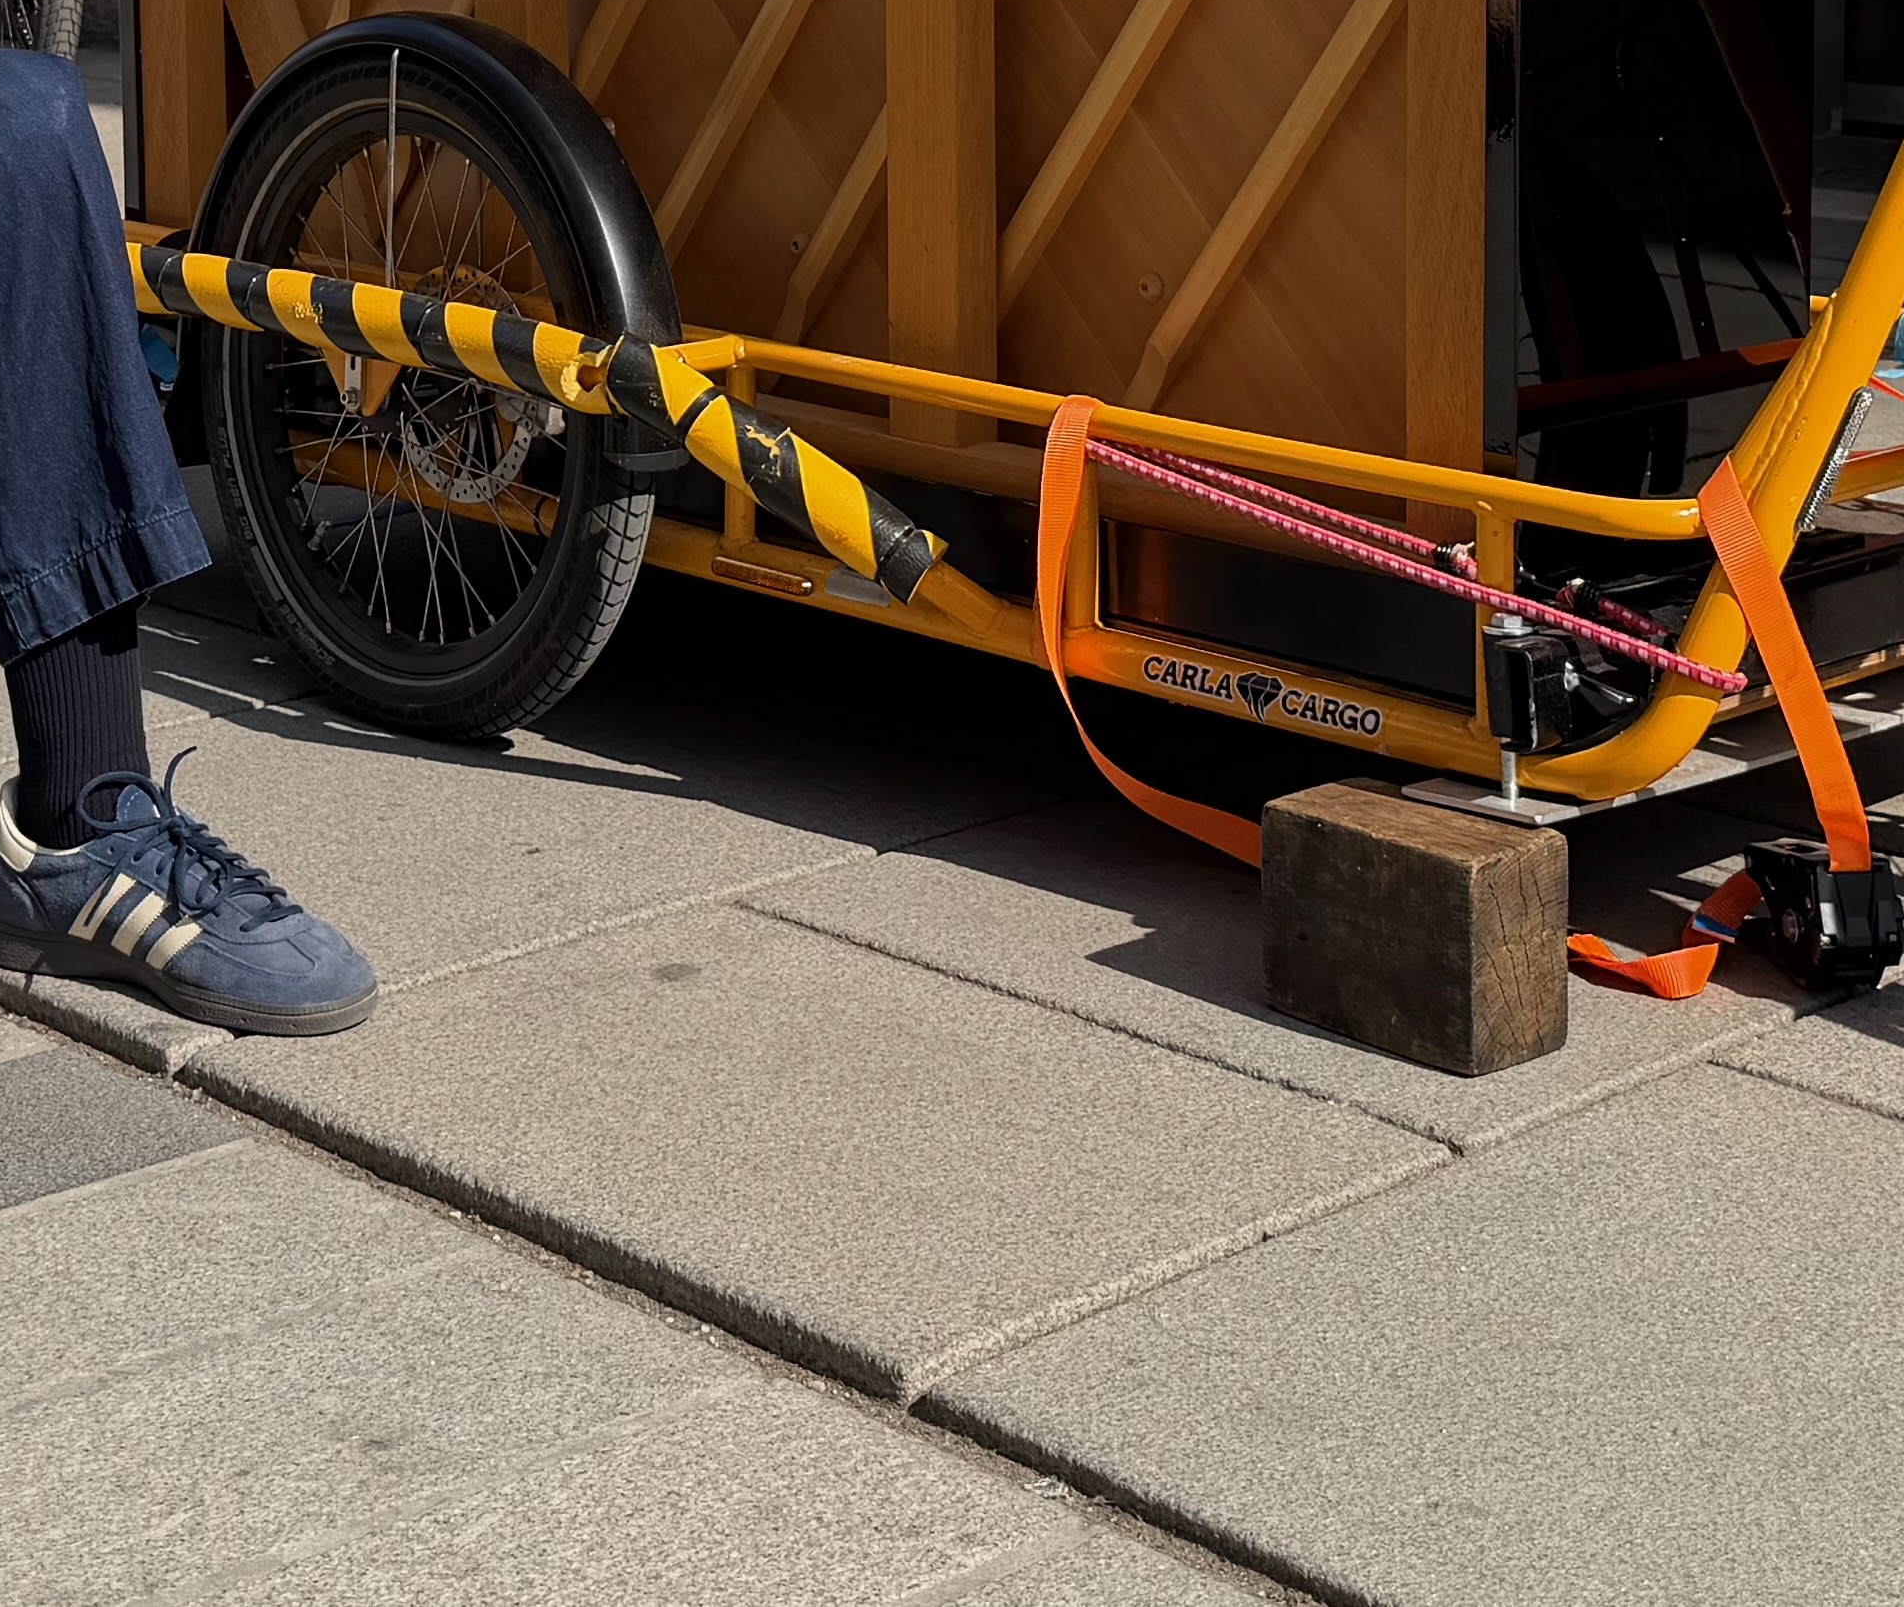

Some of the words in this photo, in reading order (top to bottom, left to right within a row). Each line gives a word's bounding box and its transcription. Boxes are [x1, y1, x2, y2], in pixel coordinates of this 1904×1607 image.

[216, 425, 232, 470] PLUS
[279, 603, 337, 669] SCHWALBE
[1142, 655, 1235, 702] CARLA
[1281, 690, 1382, 737] CARGO
